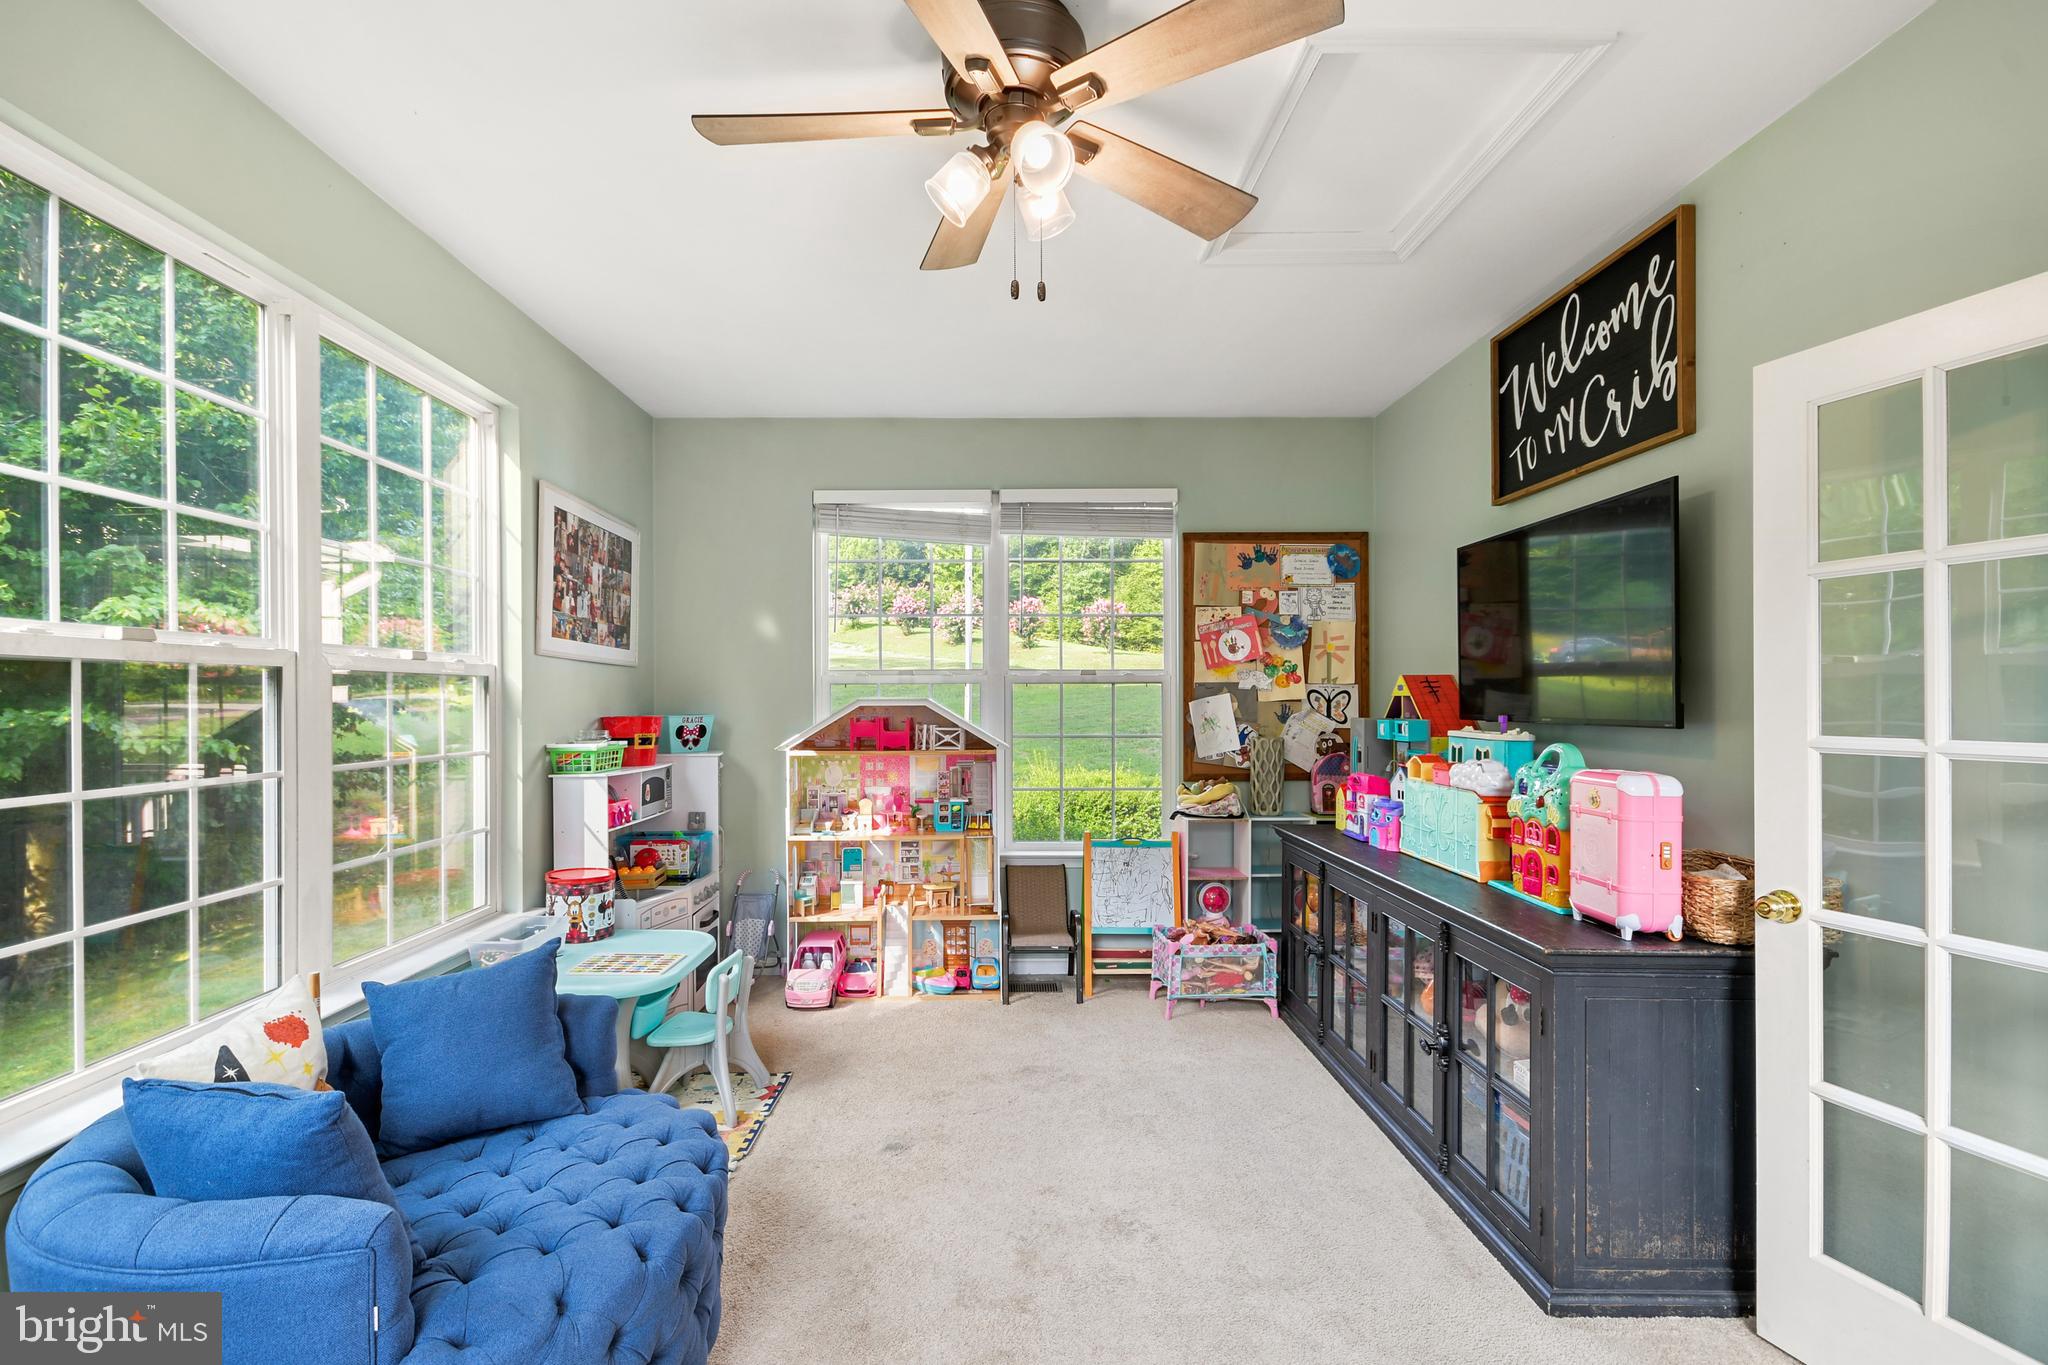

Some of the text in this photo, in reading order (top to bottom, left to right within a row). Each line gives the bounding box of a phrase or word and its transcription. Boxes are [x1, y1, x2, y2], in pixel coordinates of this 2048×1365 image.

[1500, 254, 1675, 430] Welcome
[1509, 294, 1678, 481] TO MY Crib
[682, 716, 704, 724] GRACIE
